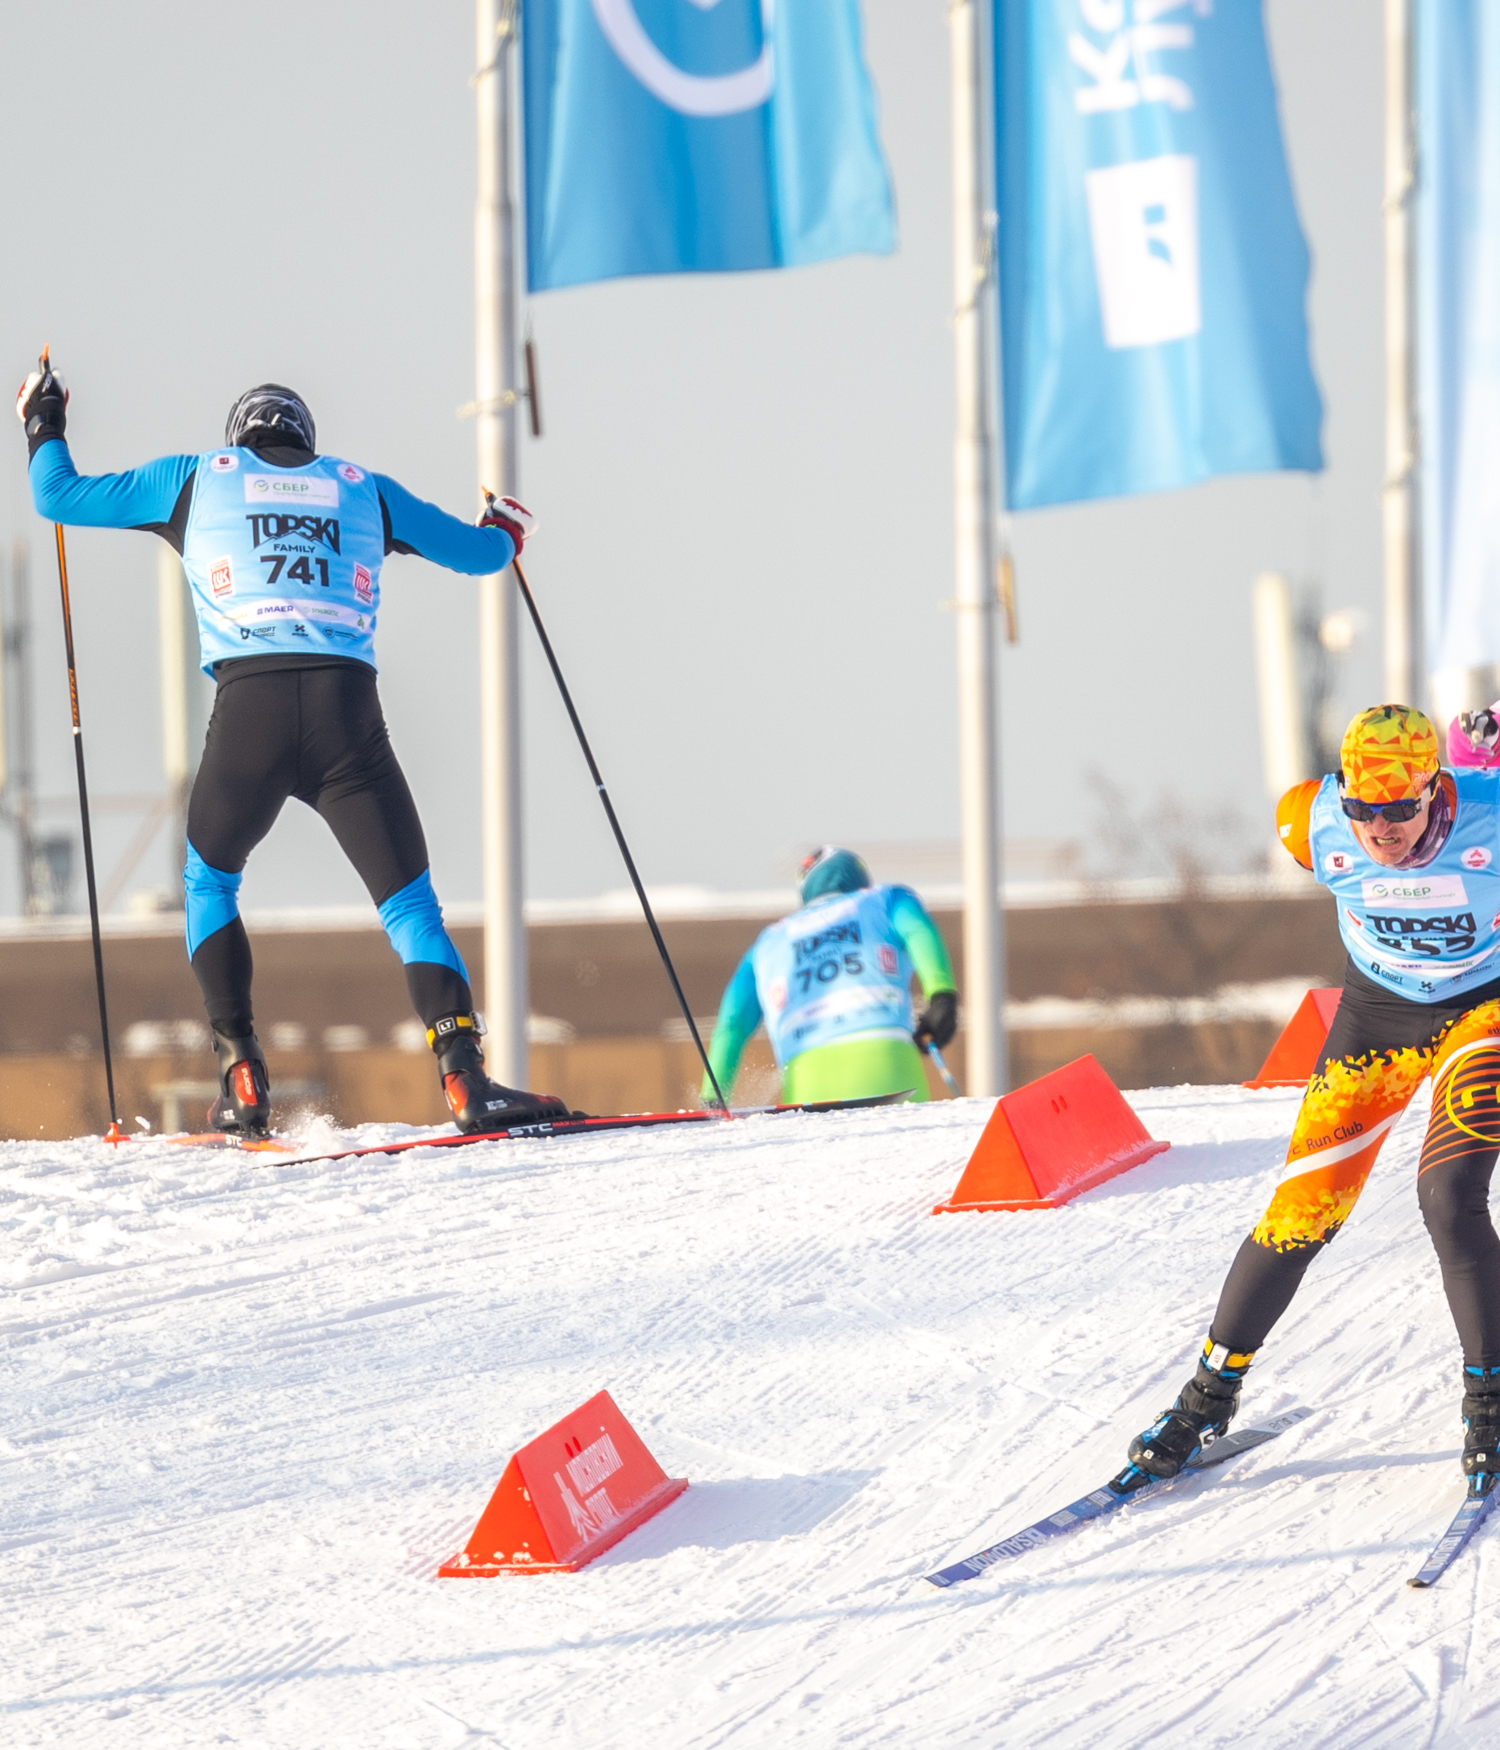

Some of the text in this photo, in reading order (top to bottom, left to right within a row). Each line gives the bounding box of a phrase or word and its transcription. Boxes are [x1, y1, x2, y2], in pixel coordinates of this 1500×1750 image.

[272, 482, 309, 493] СБЕР
[246, 513, 341, 556] TOPSKI
[273, 543, 316, 554] FAMILY
[260, 555, 330, 587] 741
[264, 605, 294, 614] MAER
[1392, 887, 1431, 897] СБЕР
[1365, 912, 1477, 935] TOPSKI
[796, 951, 864, 993] 705
[508, 1122, 554, 1138] STC
[1306, 1134, 1332, 1152] Run
[1333, 1121, 1364, 1142] Club
[962, 1532, 1035, 1574] SALOMON
